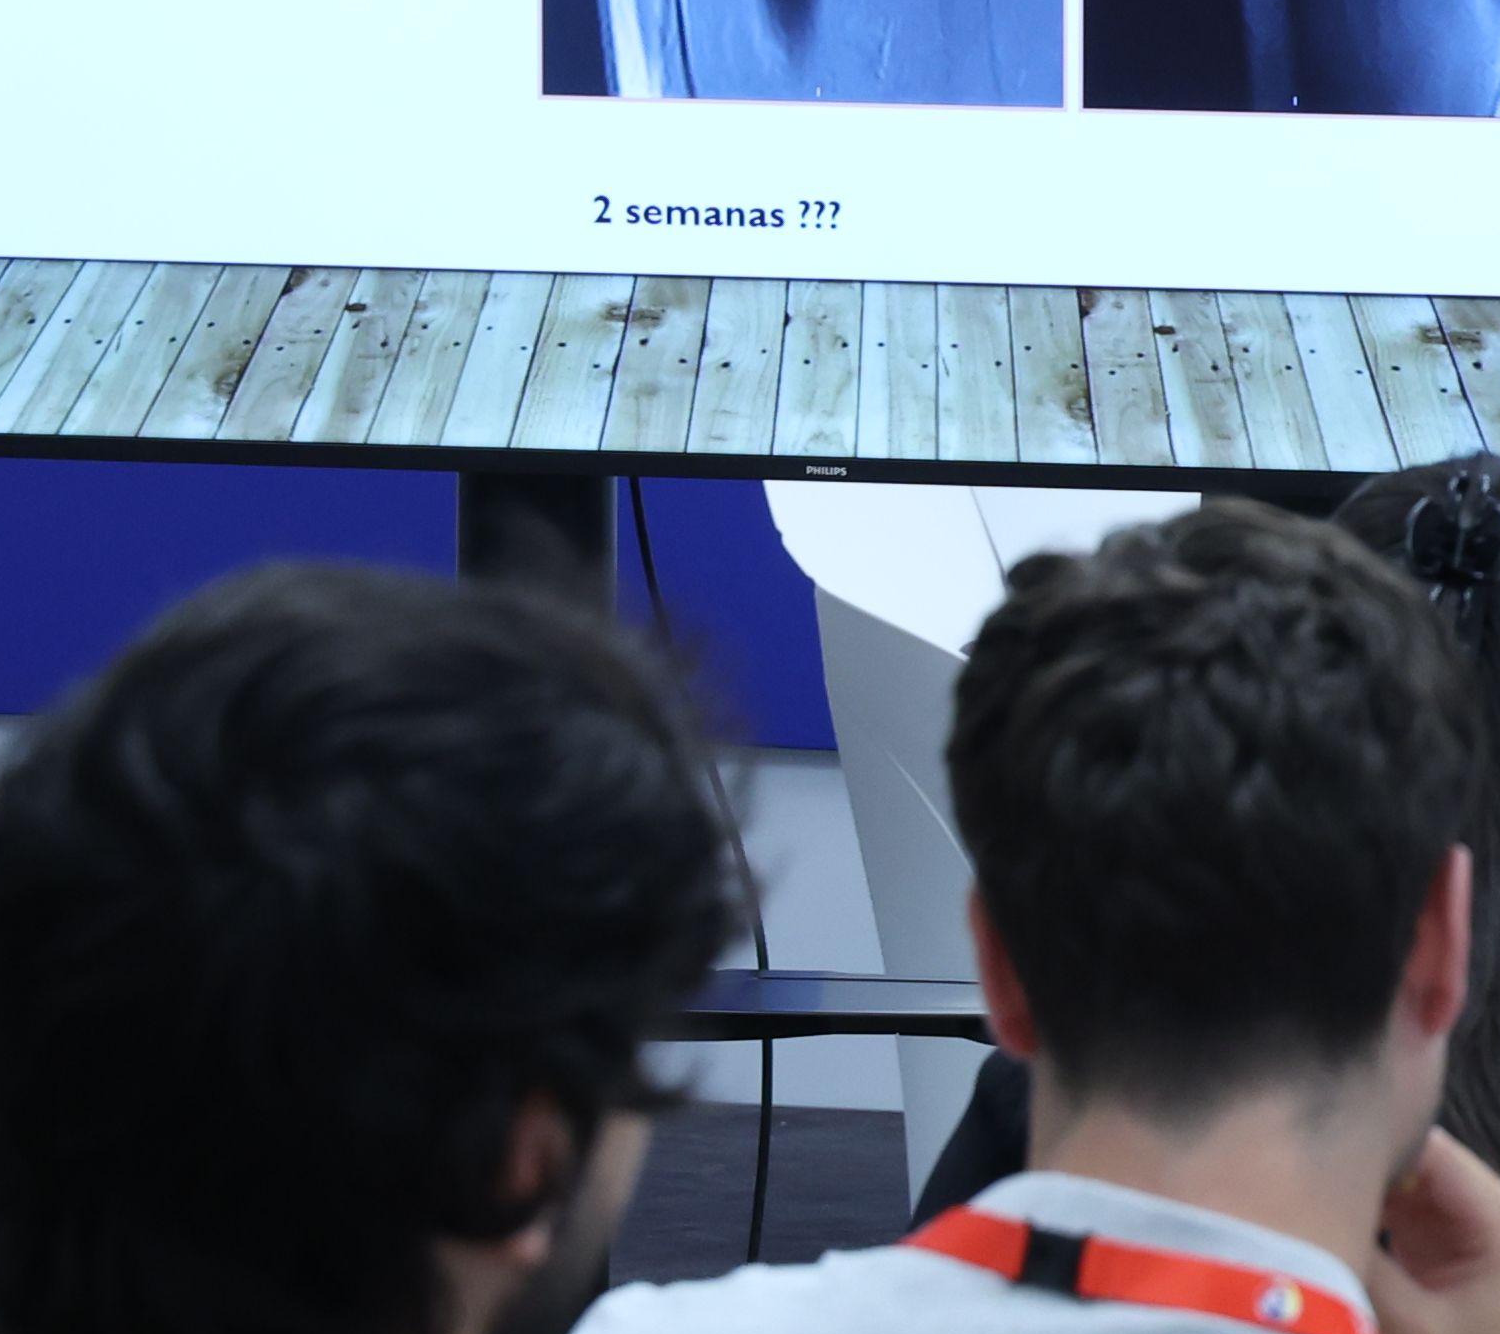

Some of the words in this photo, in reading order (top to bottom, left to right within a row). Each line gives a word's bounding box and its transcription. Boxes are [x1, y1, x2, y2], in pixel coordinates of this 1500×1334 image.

[592, 195, 613, 224] 2
[626, 203, 785, 228] semanas
[798, 200, 841, 229] ???
[805, 464, 848, 476] PHILIPS
